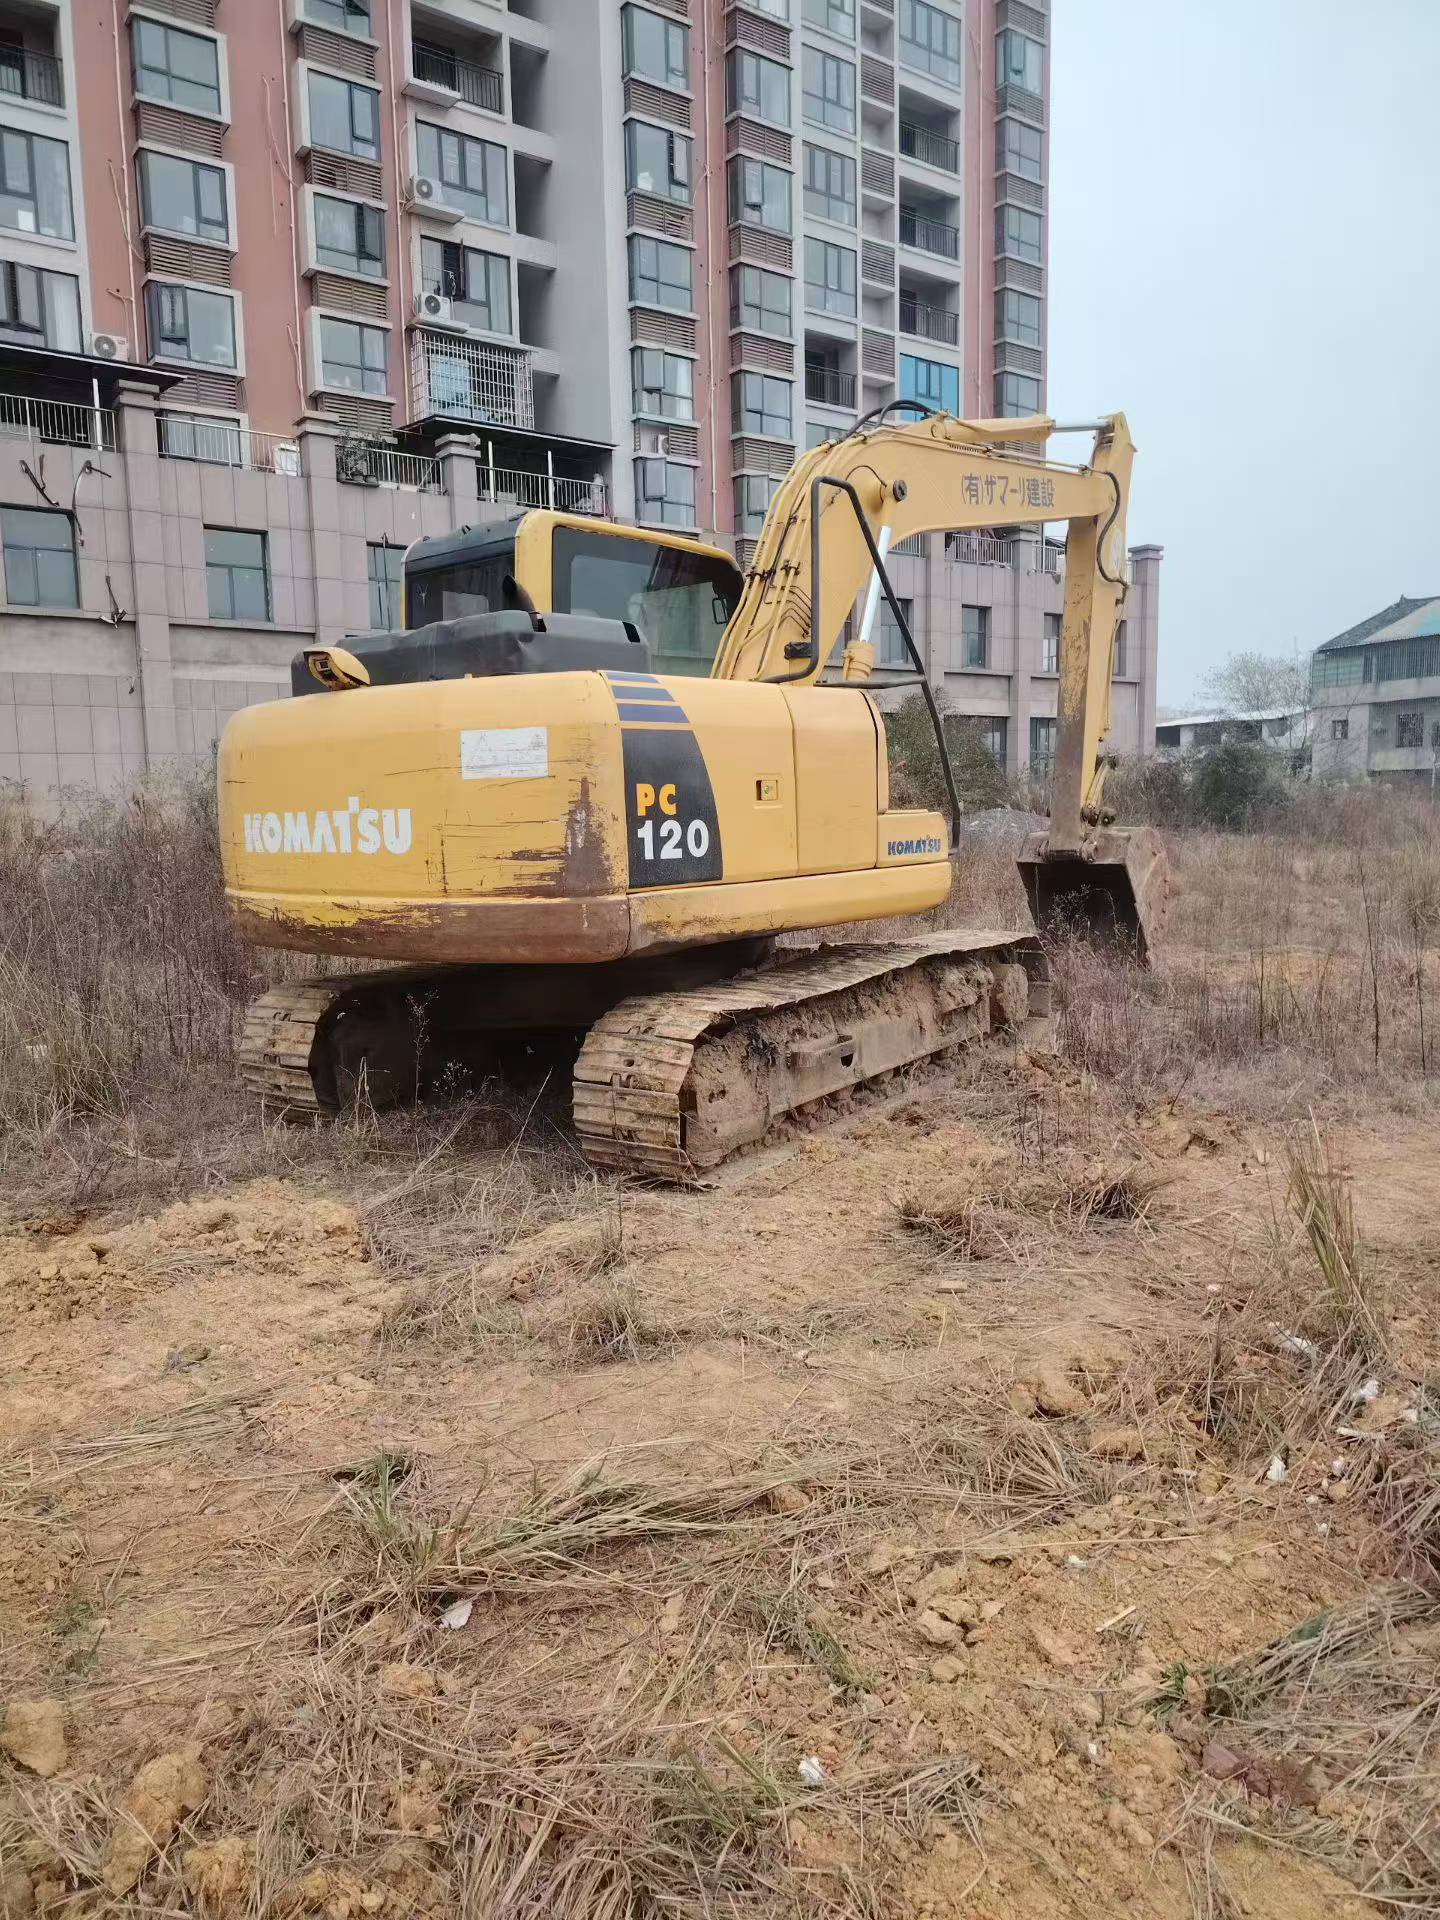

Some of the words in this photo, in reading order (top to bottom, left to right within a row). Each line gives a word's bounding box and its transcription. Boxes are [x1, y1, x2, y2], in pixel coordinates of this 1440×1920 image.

[636, 783, 677, 817] PC
[243, 796, 412, 854] KOMATSU
[637, 819, 710, 860] 120
[887, 834, 942, 856] KOMATSU
